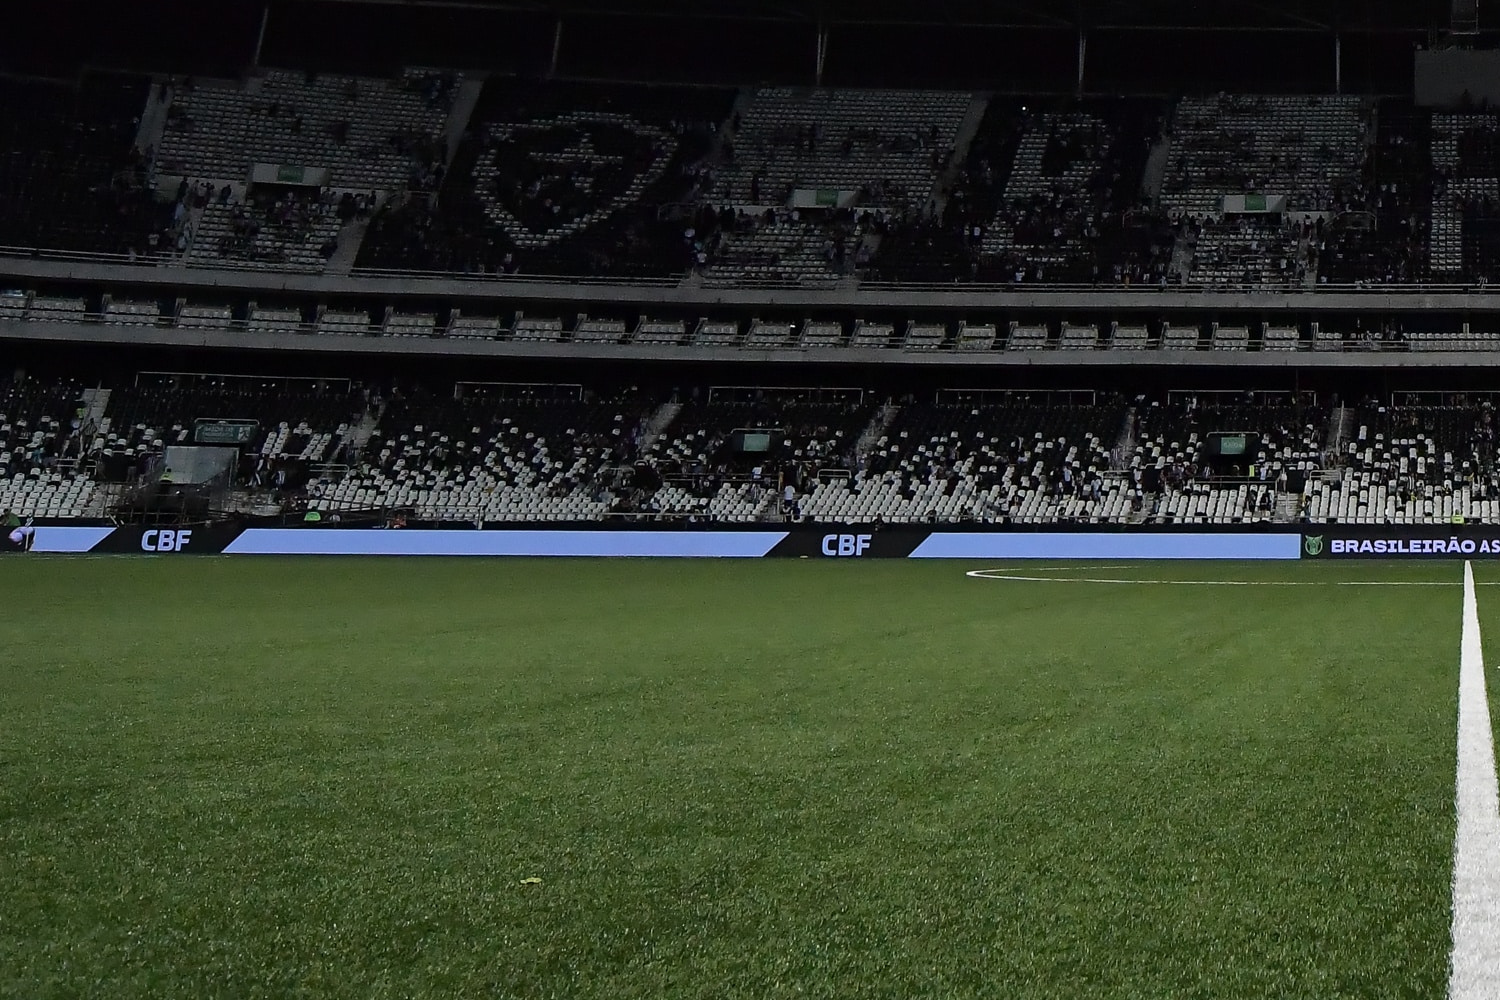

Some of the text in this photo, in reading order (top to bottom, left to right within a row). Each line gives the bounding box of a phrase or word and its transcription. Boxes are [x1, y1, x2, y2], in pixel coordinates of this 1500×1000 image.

[141, 529, 193, 552] CBF
[821, 534, 873, 556] CBF
[1331, 536, 1476, 554] BRASILEIRÃO
